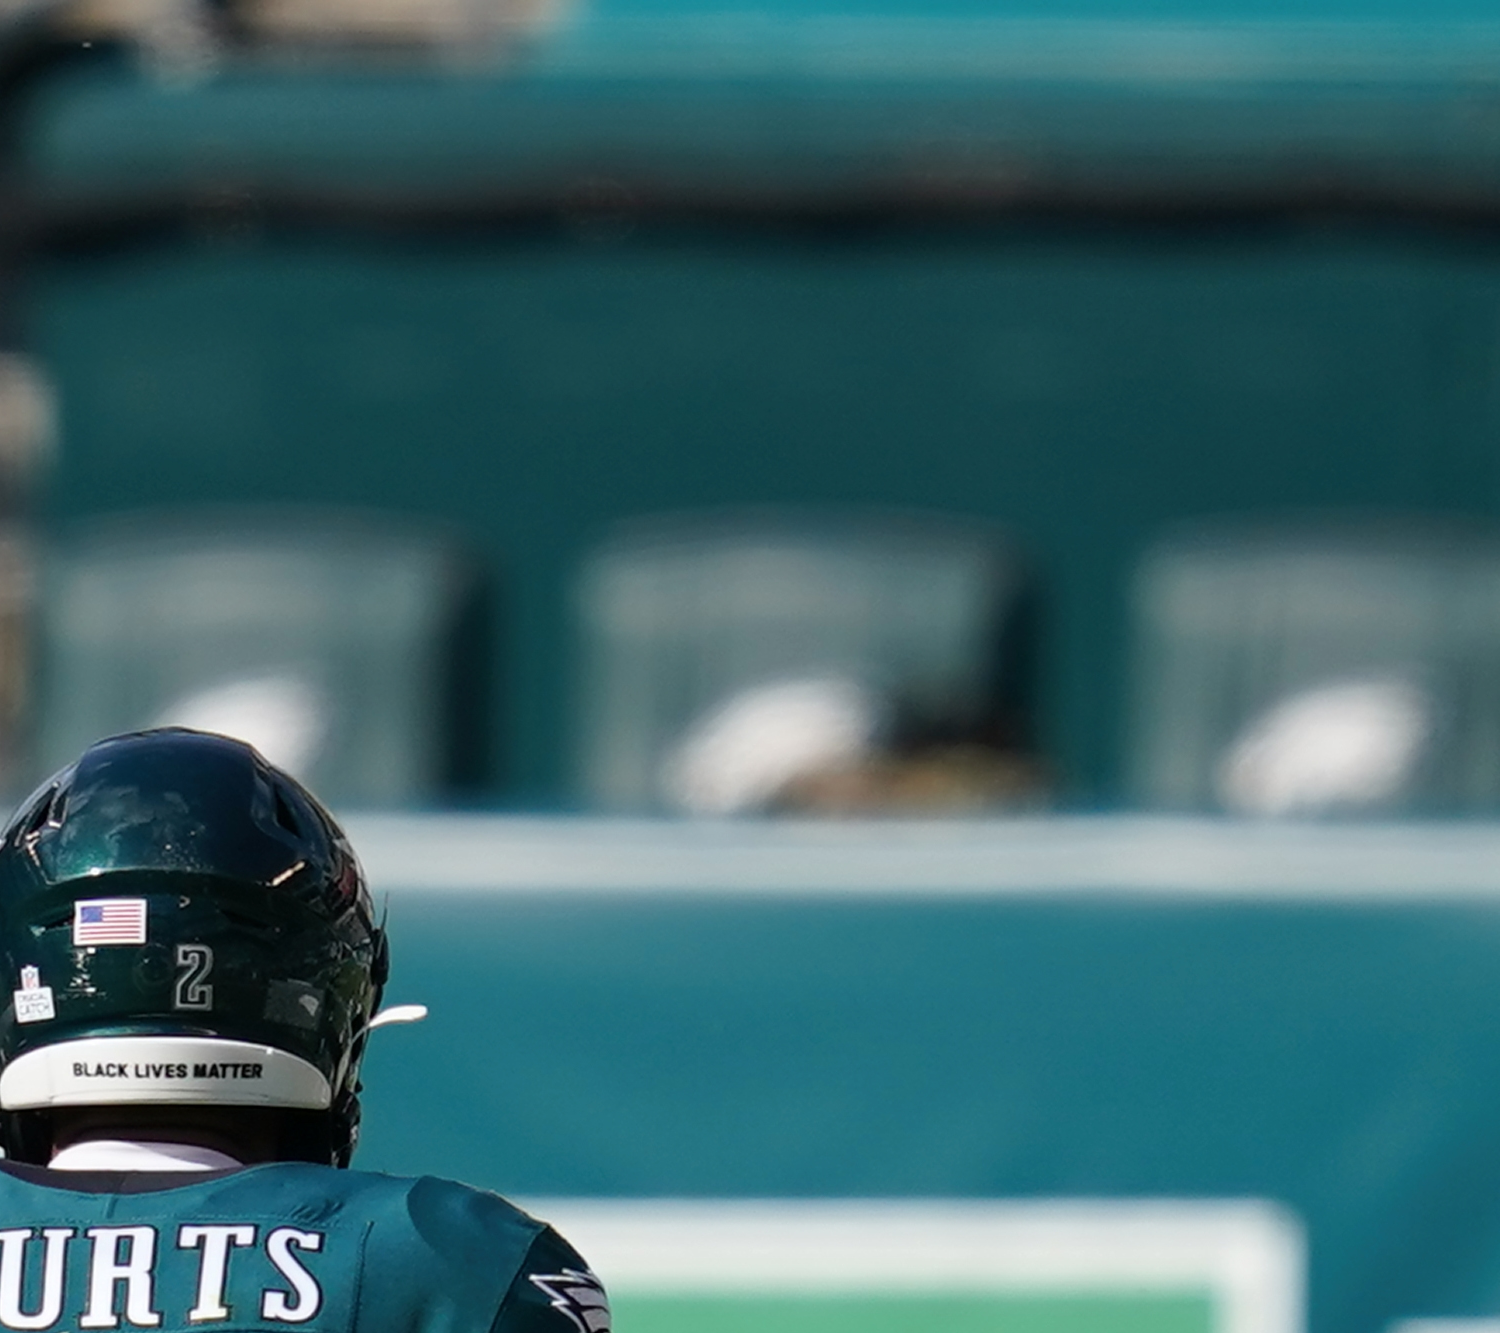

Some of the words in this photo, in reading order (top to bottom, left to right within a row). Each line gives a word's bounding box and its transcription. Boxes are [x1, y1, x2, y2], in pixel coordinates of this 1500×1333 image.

[175, 943, 214, 1012] 2
[73, 1063, 128, 1078] BLACK
[135, 1064, 187, 1079] LIVES
[193, 1064, 263, 1079] MATTER
